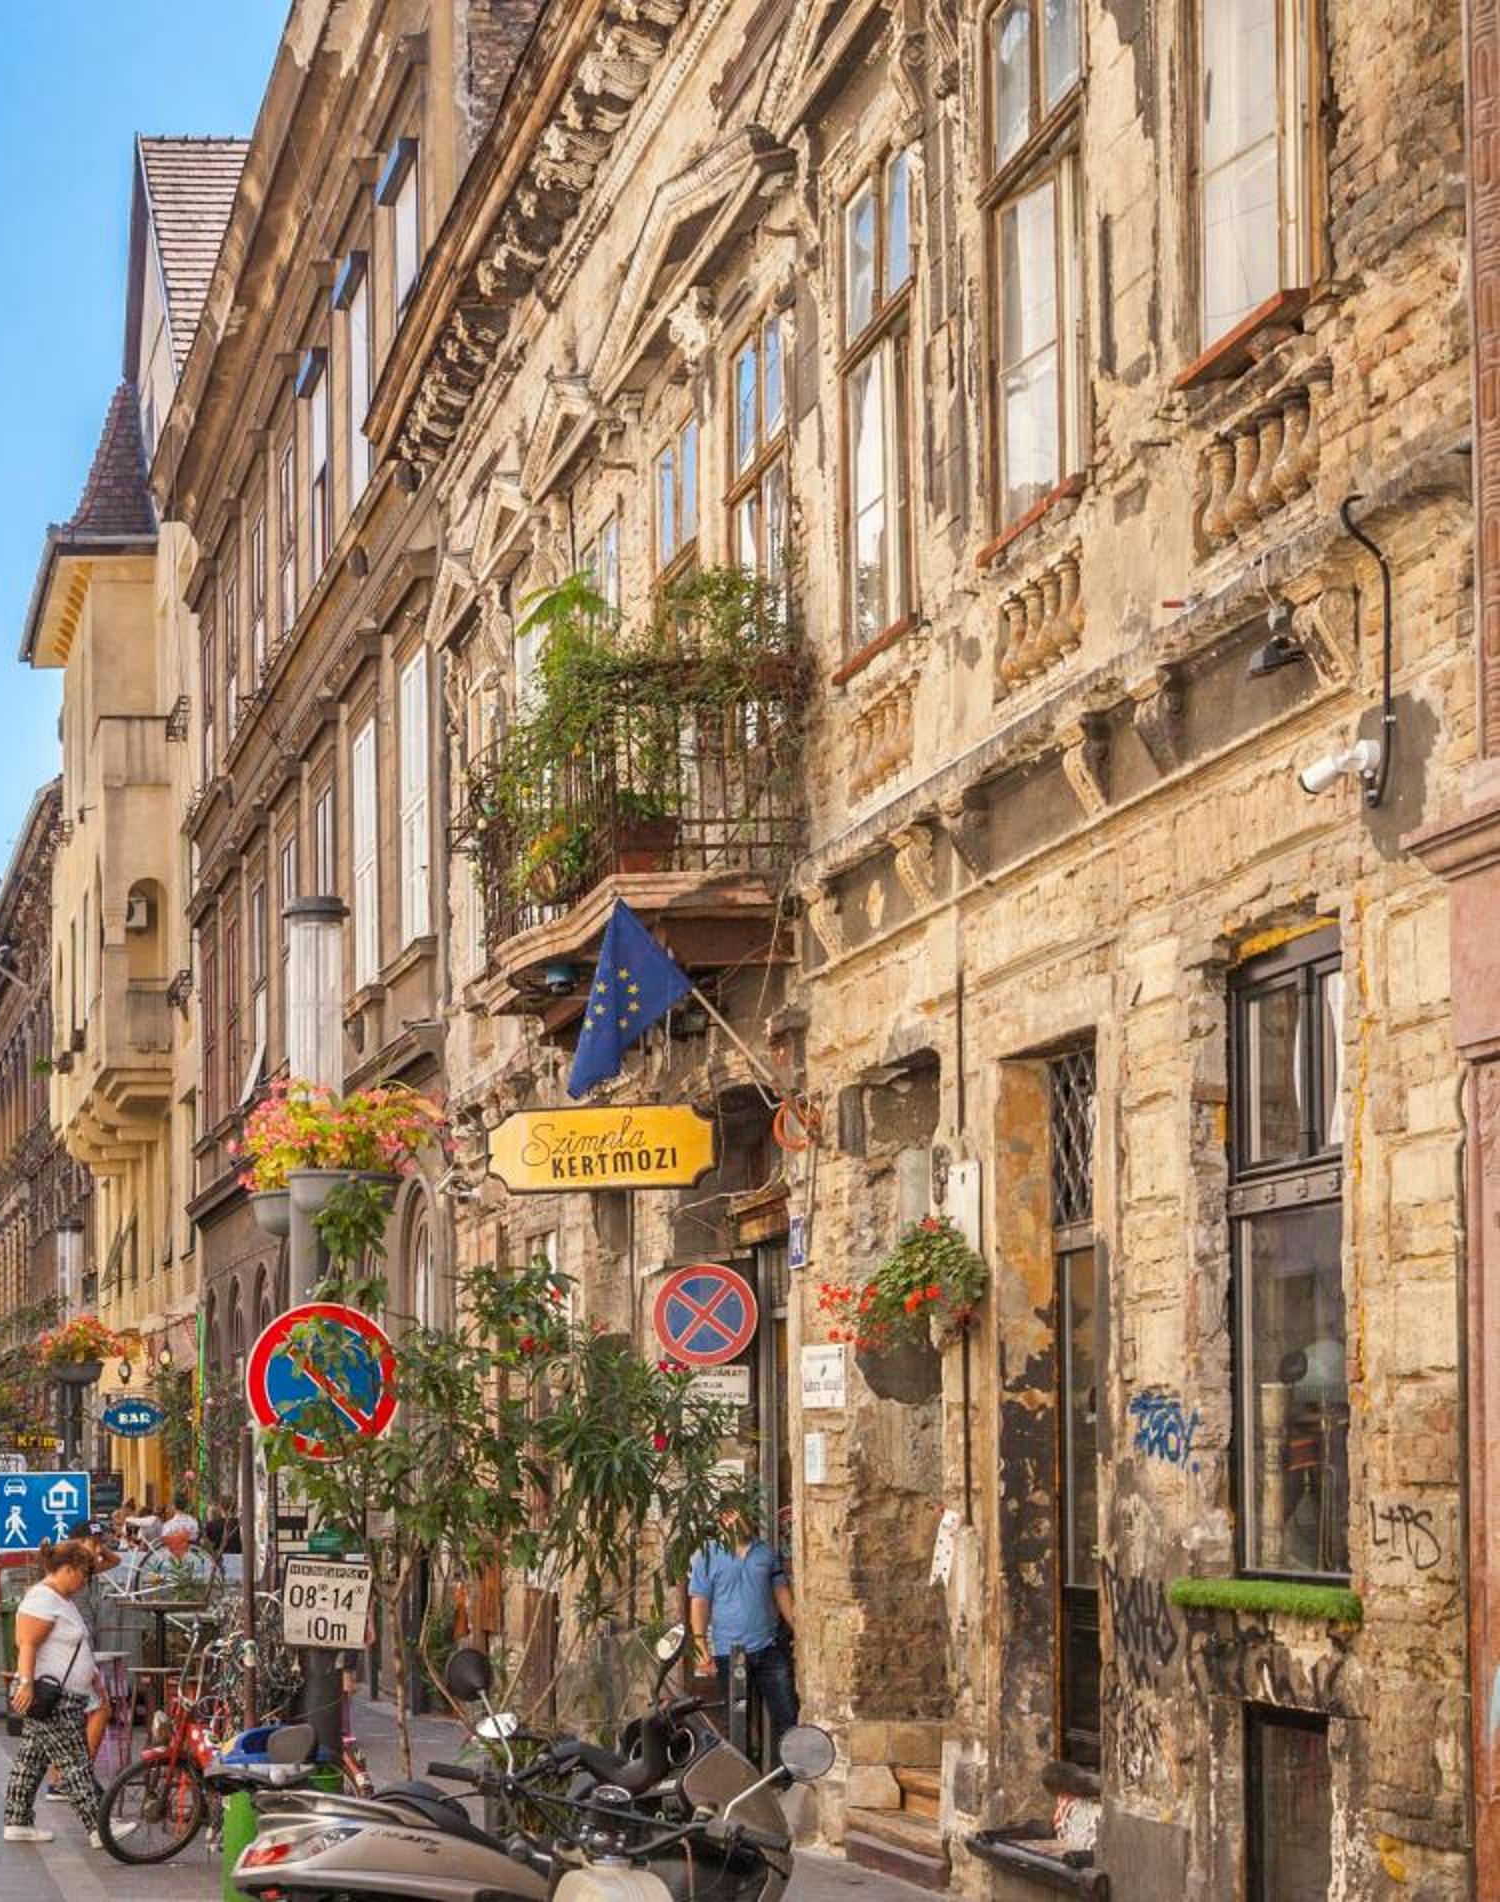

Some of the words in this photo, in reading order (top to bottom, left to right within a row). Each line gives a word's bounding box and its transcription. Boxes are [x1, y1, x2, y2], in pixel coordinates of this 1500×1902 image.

[552, 1147, 677, 1179] KERTMOZI
[117, 1411, 151, 1425] BAR
[307, 1616, 348, 1642] 10m
